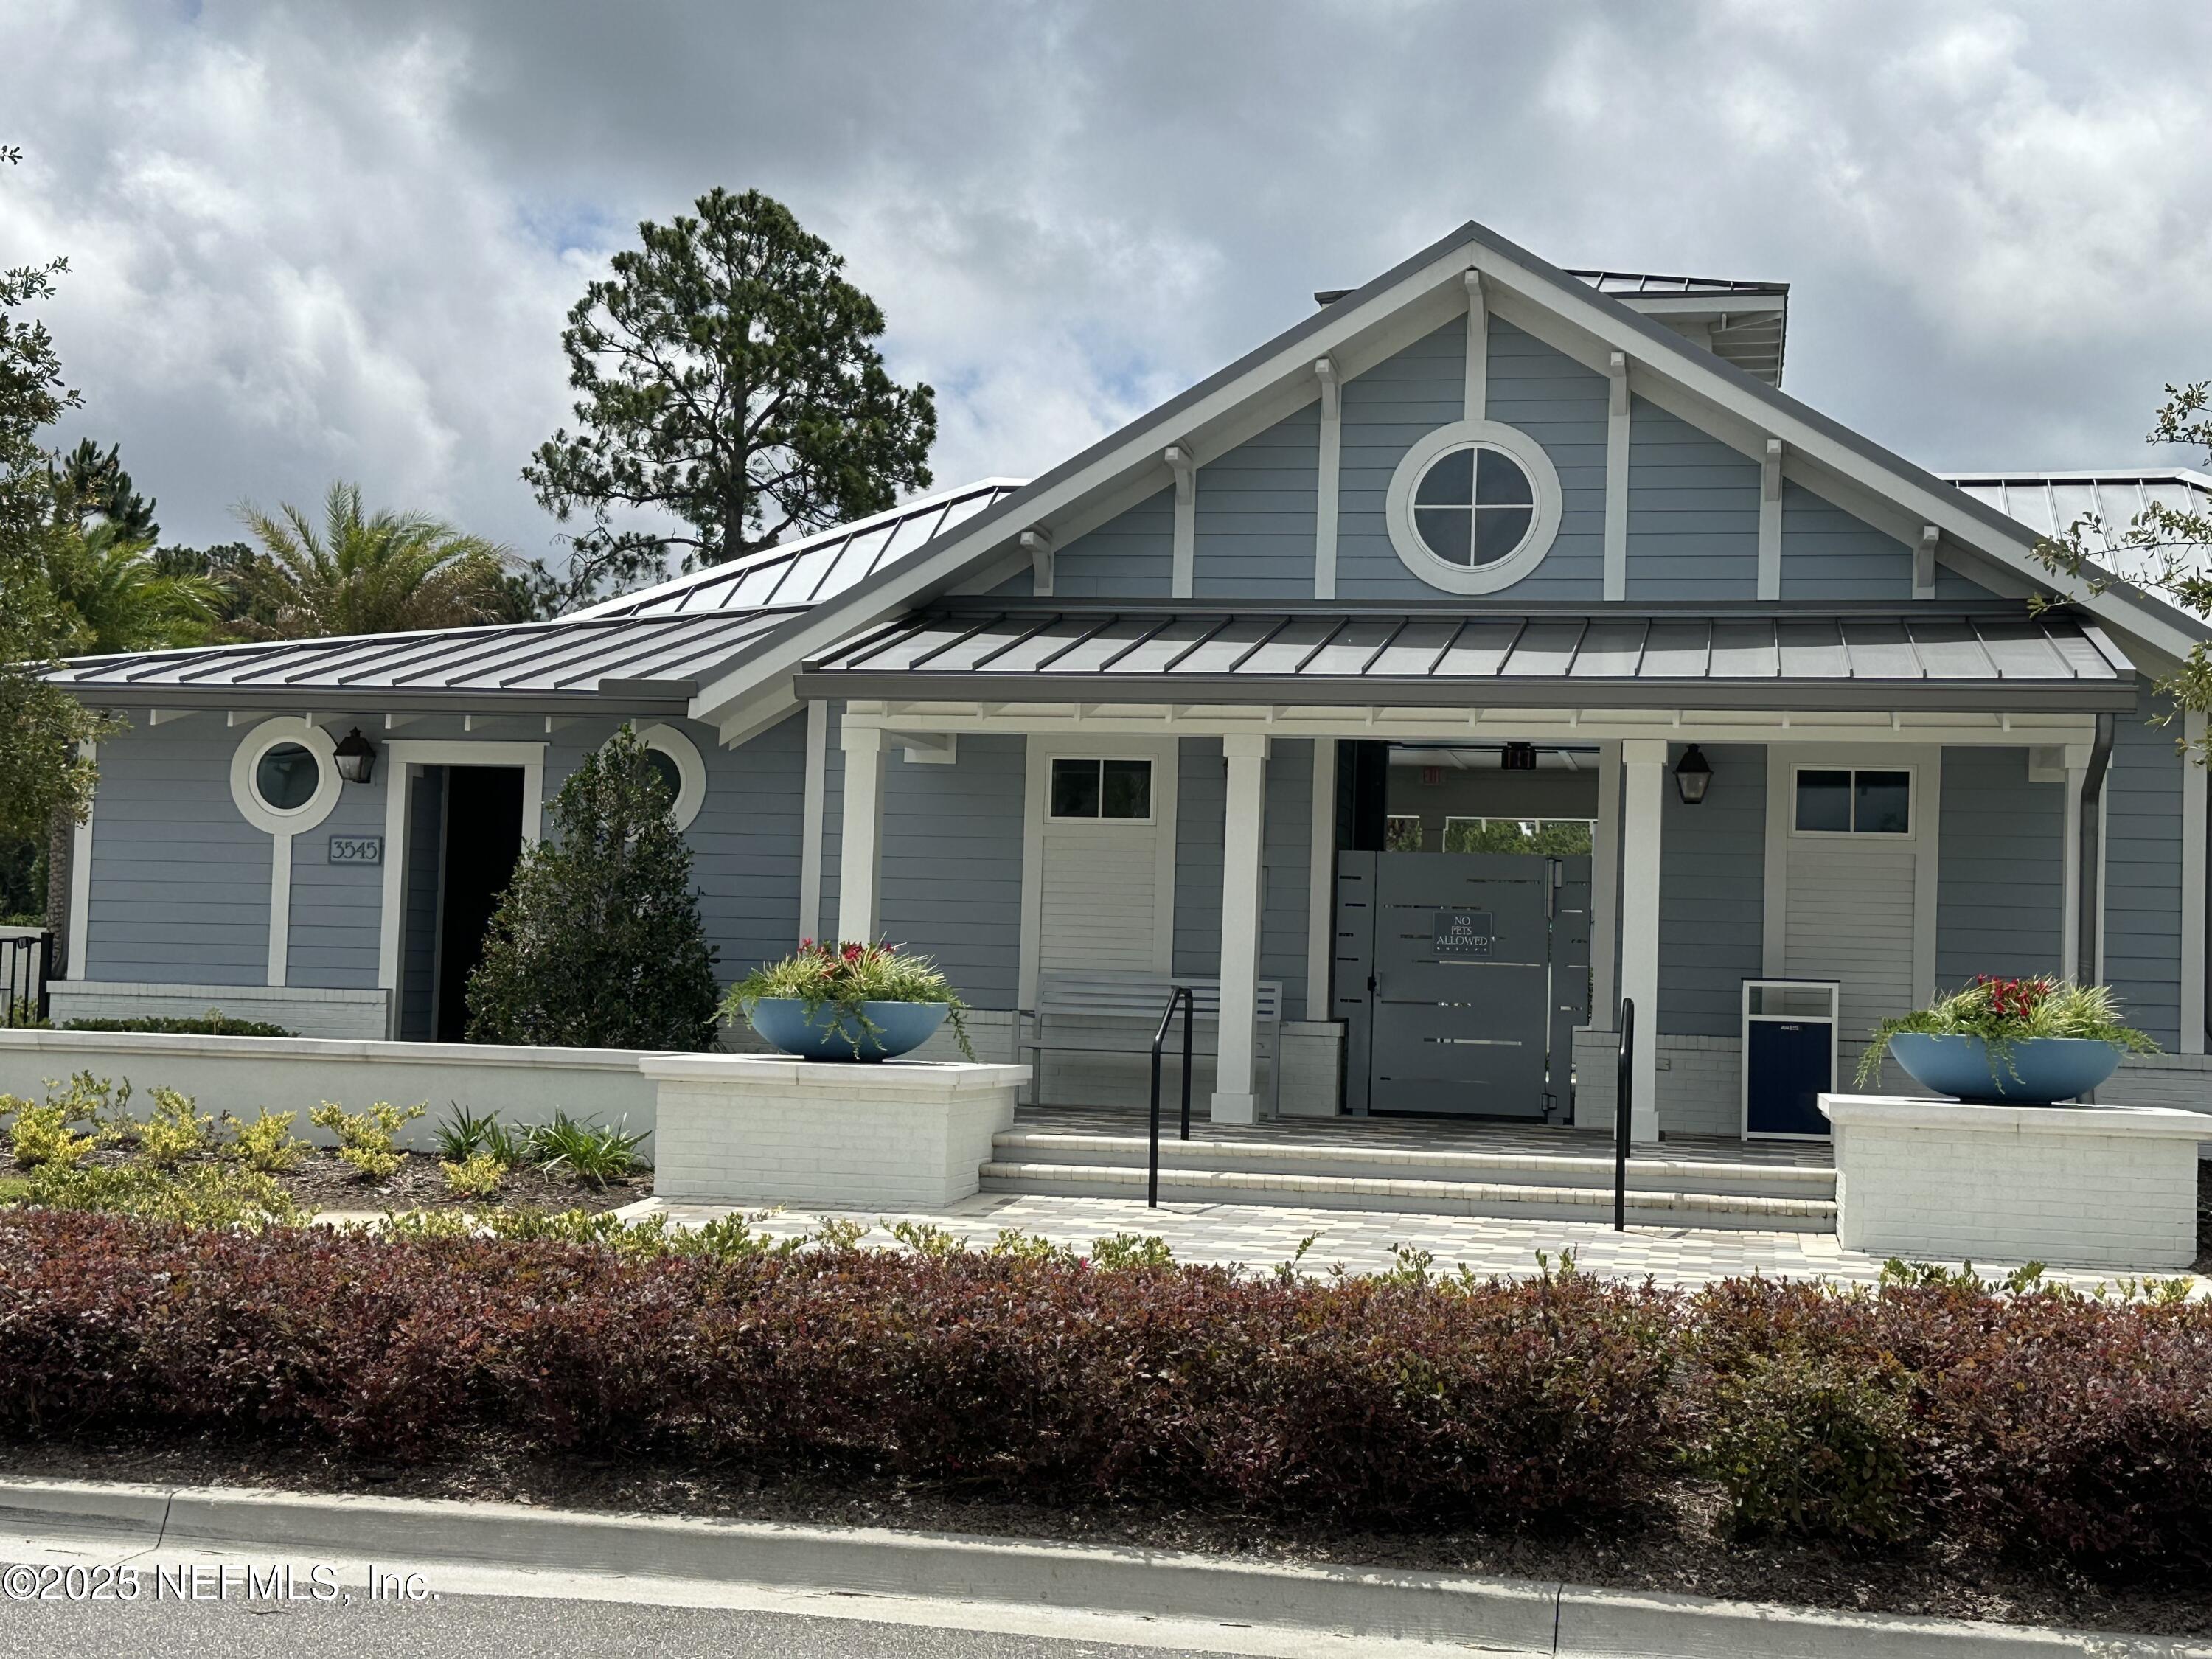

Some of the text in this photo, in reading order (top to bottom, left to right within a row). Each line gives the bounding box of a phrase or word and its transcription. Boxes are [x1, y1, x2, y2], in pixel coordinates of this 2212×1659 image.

[331, 841, 378, 860] 3545
[1455, 916, 1470, 925] NO
[1451, 925, 1472, 935] PETS
[1437, 936, 1488, 946] ALLOWED
